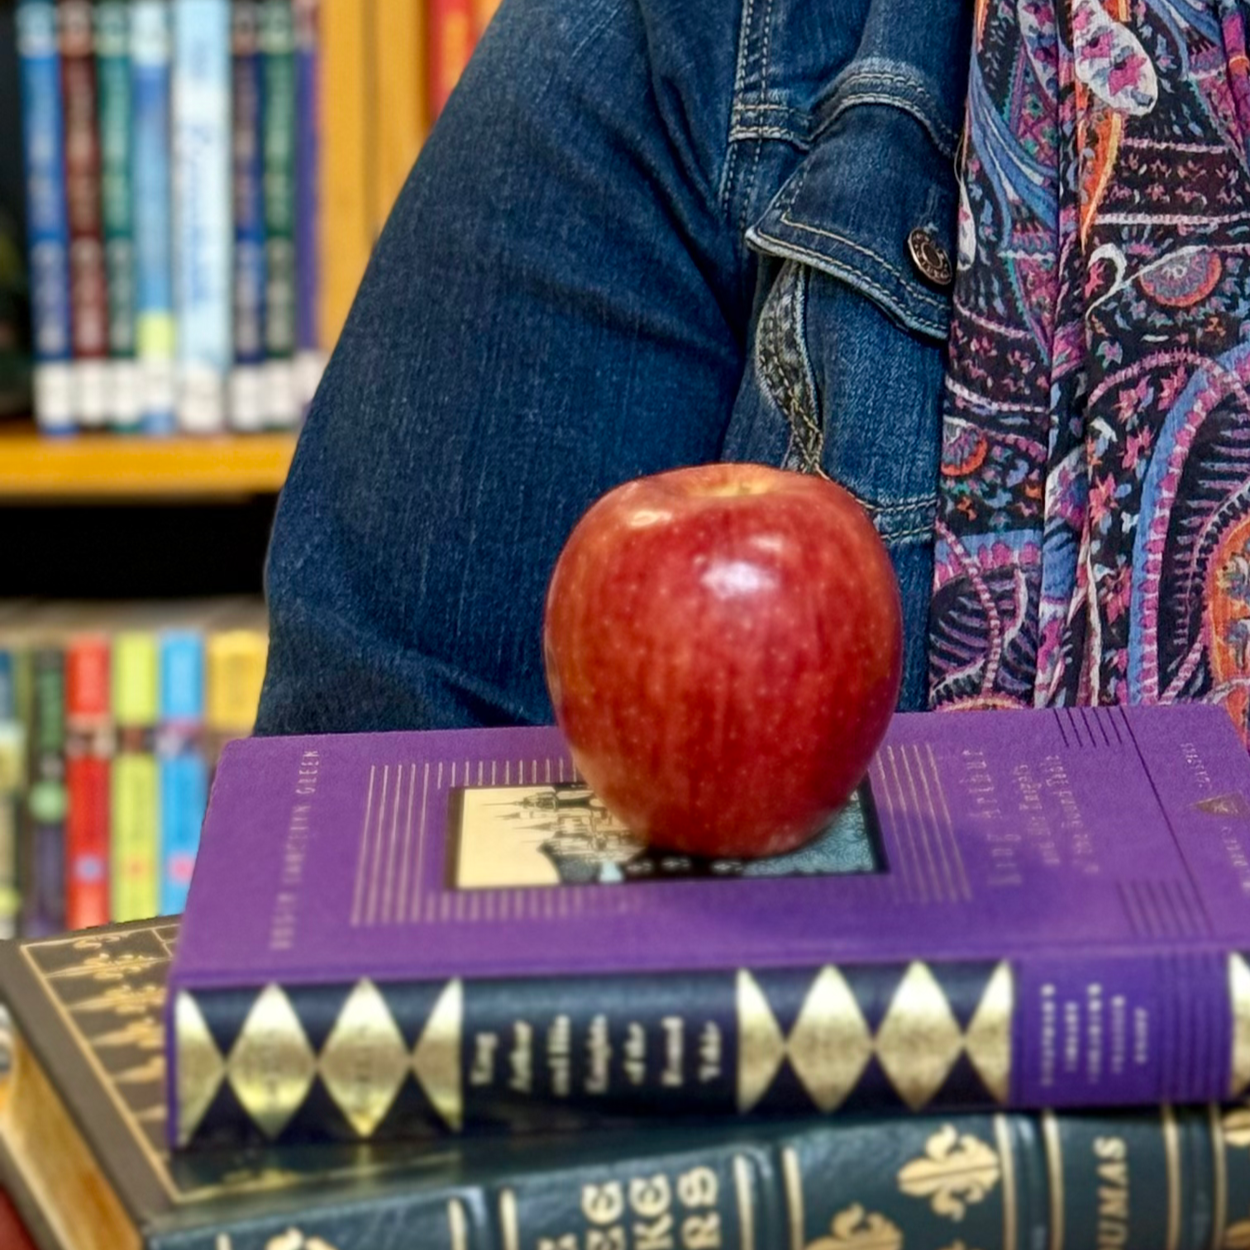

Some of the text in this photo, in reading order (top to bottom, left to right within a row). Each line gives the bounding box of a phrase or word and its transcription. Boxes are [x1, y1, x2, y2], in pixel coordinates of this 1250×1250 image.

[295, 751, 320, 794] GREEN
[960, 750, 1002, 819] Arthur
[1094, 1136, 1129, 1250] UMAS
